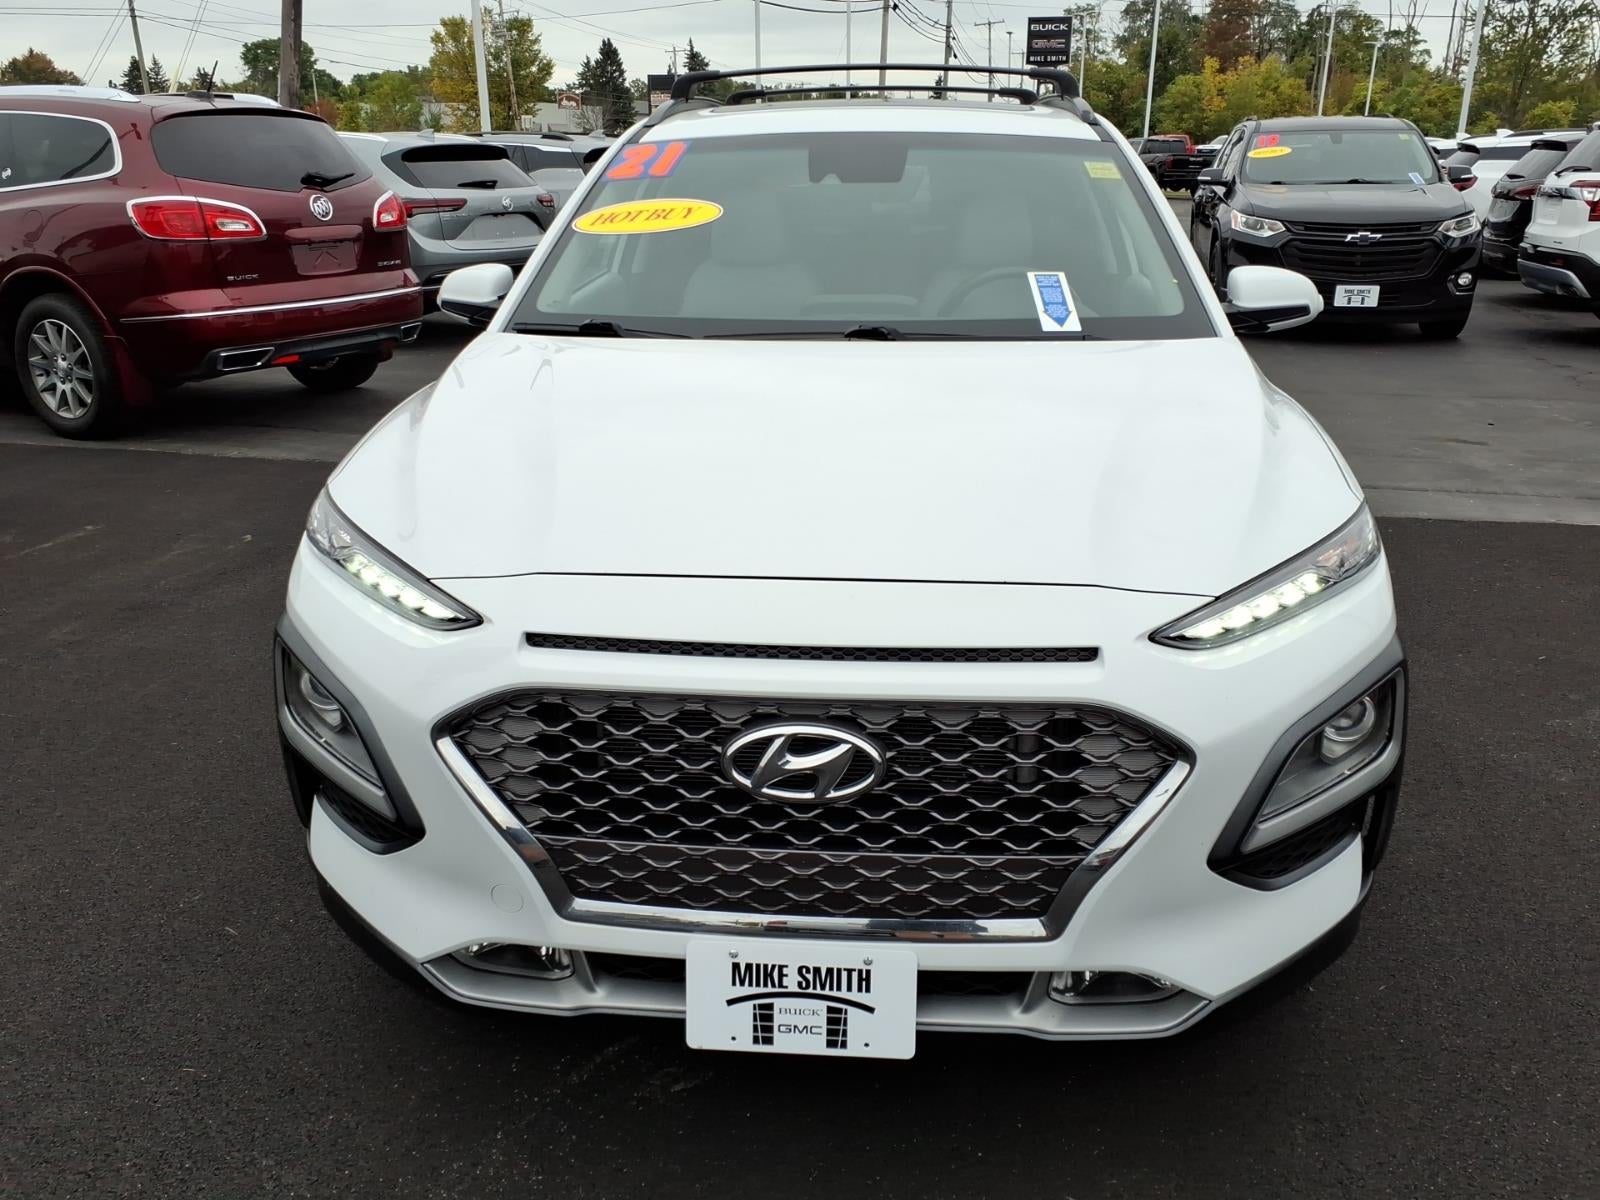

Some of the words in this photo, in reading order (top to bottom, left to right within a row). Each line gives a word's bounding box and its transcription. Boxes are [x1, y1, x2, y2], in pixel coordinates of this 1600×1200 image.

[1032, 39, 1065, 48] GMC
[606, 141, 688, 180] 21
[590, 209, 650, 227] HOT
[646, 206, 703, 221] BUY
[731, 961, 789, 989] MIKE
[796, 964, 872, 994] SMITH
[778, 1007, 822, 1017] BUICK
[777, 1023, 823, 1036] GMC
